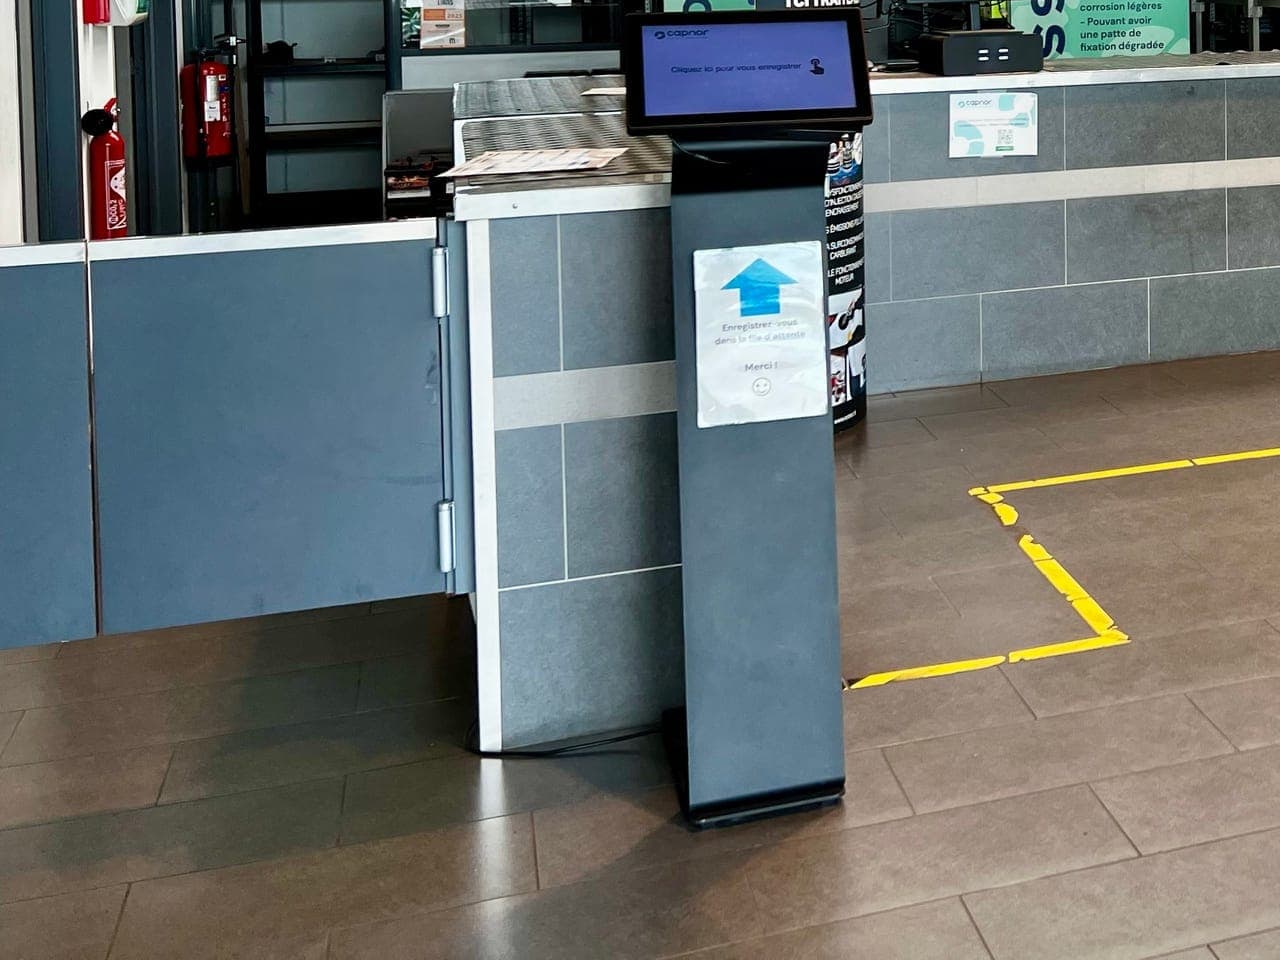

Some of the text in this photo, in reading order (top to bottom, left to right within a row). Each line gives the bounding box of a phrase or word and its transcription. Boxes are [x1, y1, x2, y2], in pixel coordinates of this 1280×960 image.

[1080, 2, 1162, 12] corrosion légères
[1087, 17, 1152, 26] Pouvant avoir
[667, 29, 709, 38] capnor
[1080, 29, 1141, 41] une patte de
[1080, 42, 1165, 53] fixation dégradée
[745, 362, 773, 372] Merci
